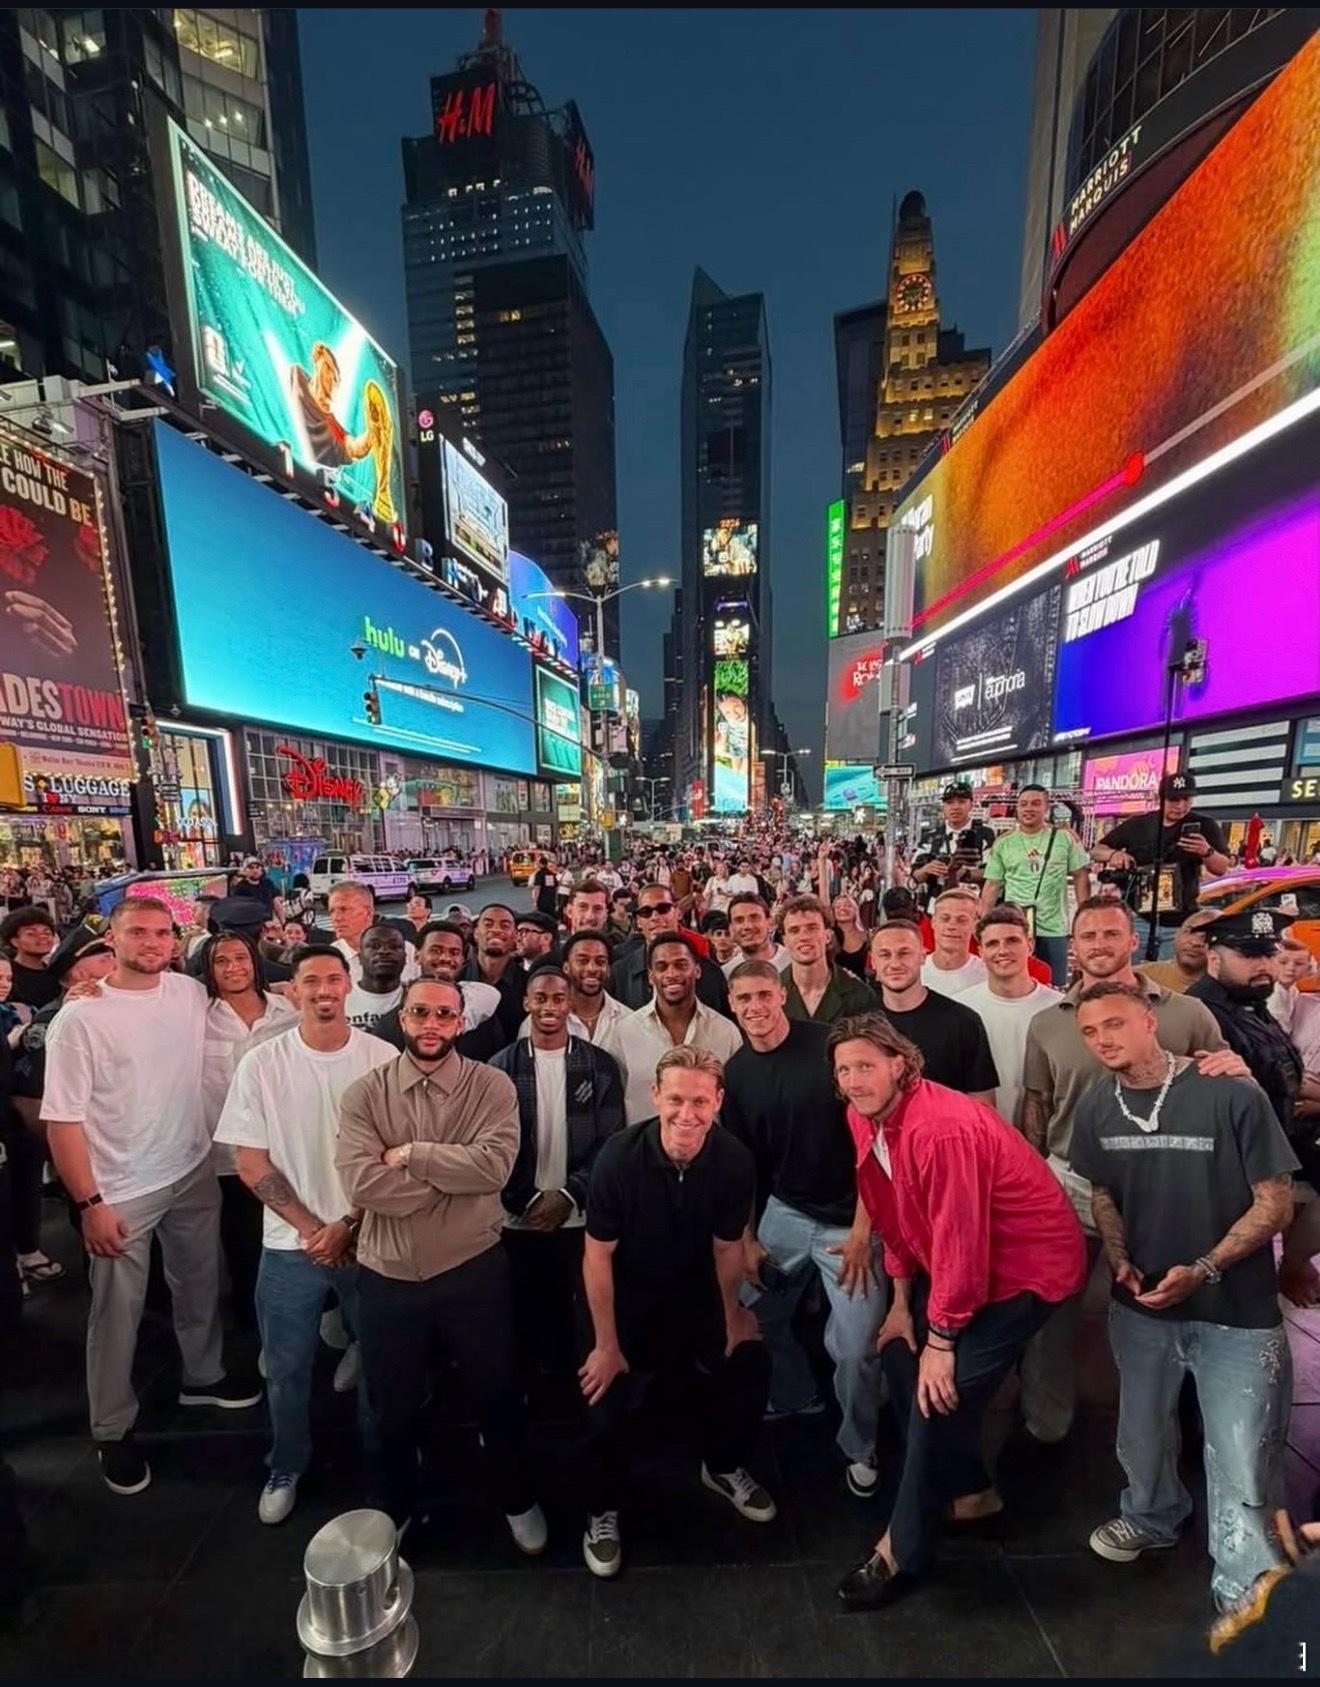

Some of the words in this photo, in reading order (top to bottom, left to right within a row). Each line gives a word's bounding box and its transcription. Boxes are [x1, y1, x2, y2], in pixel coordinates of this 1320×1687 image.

[437, 81, 497, 145] H&M
[1070, 124, 1143, 217] MARRIOTT
[1069, 157, 1130, 237] MARQUIS
[420, 429, 434, 443] LG
[14, 447, 42, 480] HOW
[43, 462, 69, 492] THE
[1, 465, 67, 516] COULD
[69, 497, 94, 528] BE
[364, 615, 405, 659] hulu
[36, 720, 77, 736] GLOBAL
[49, 776, 132, 798] LUGGAGE
[1096, 772, 1158, 791] PANDORA
[77, 805, 107, 815] SONY
